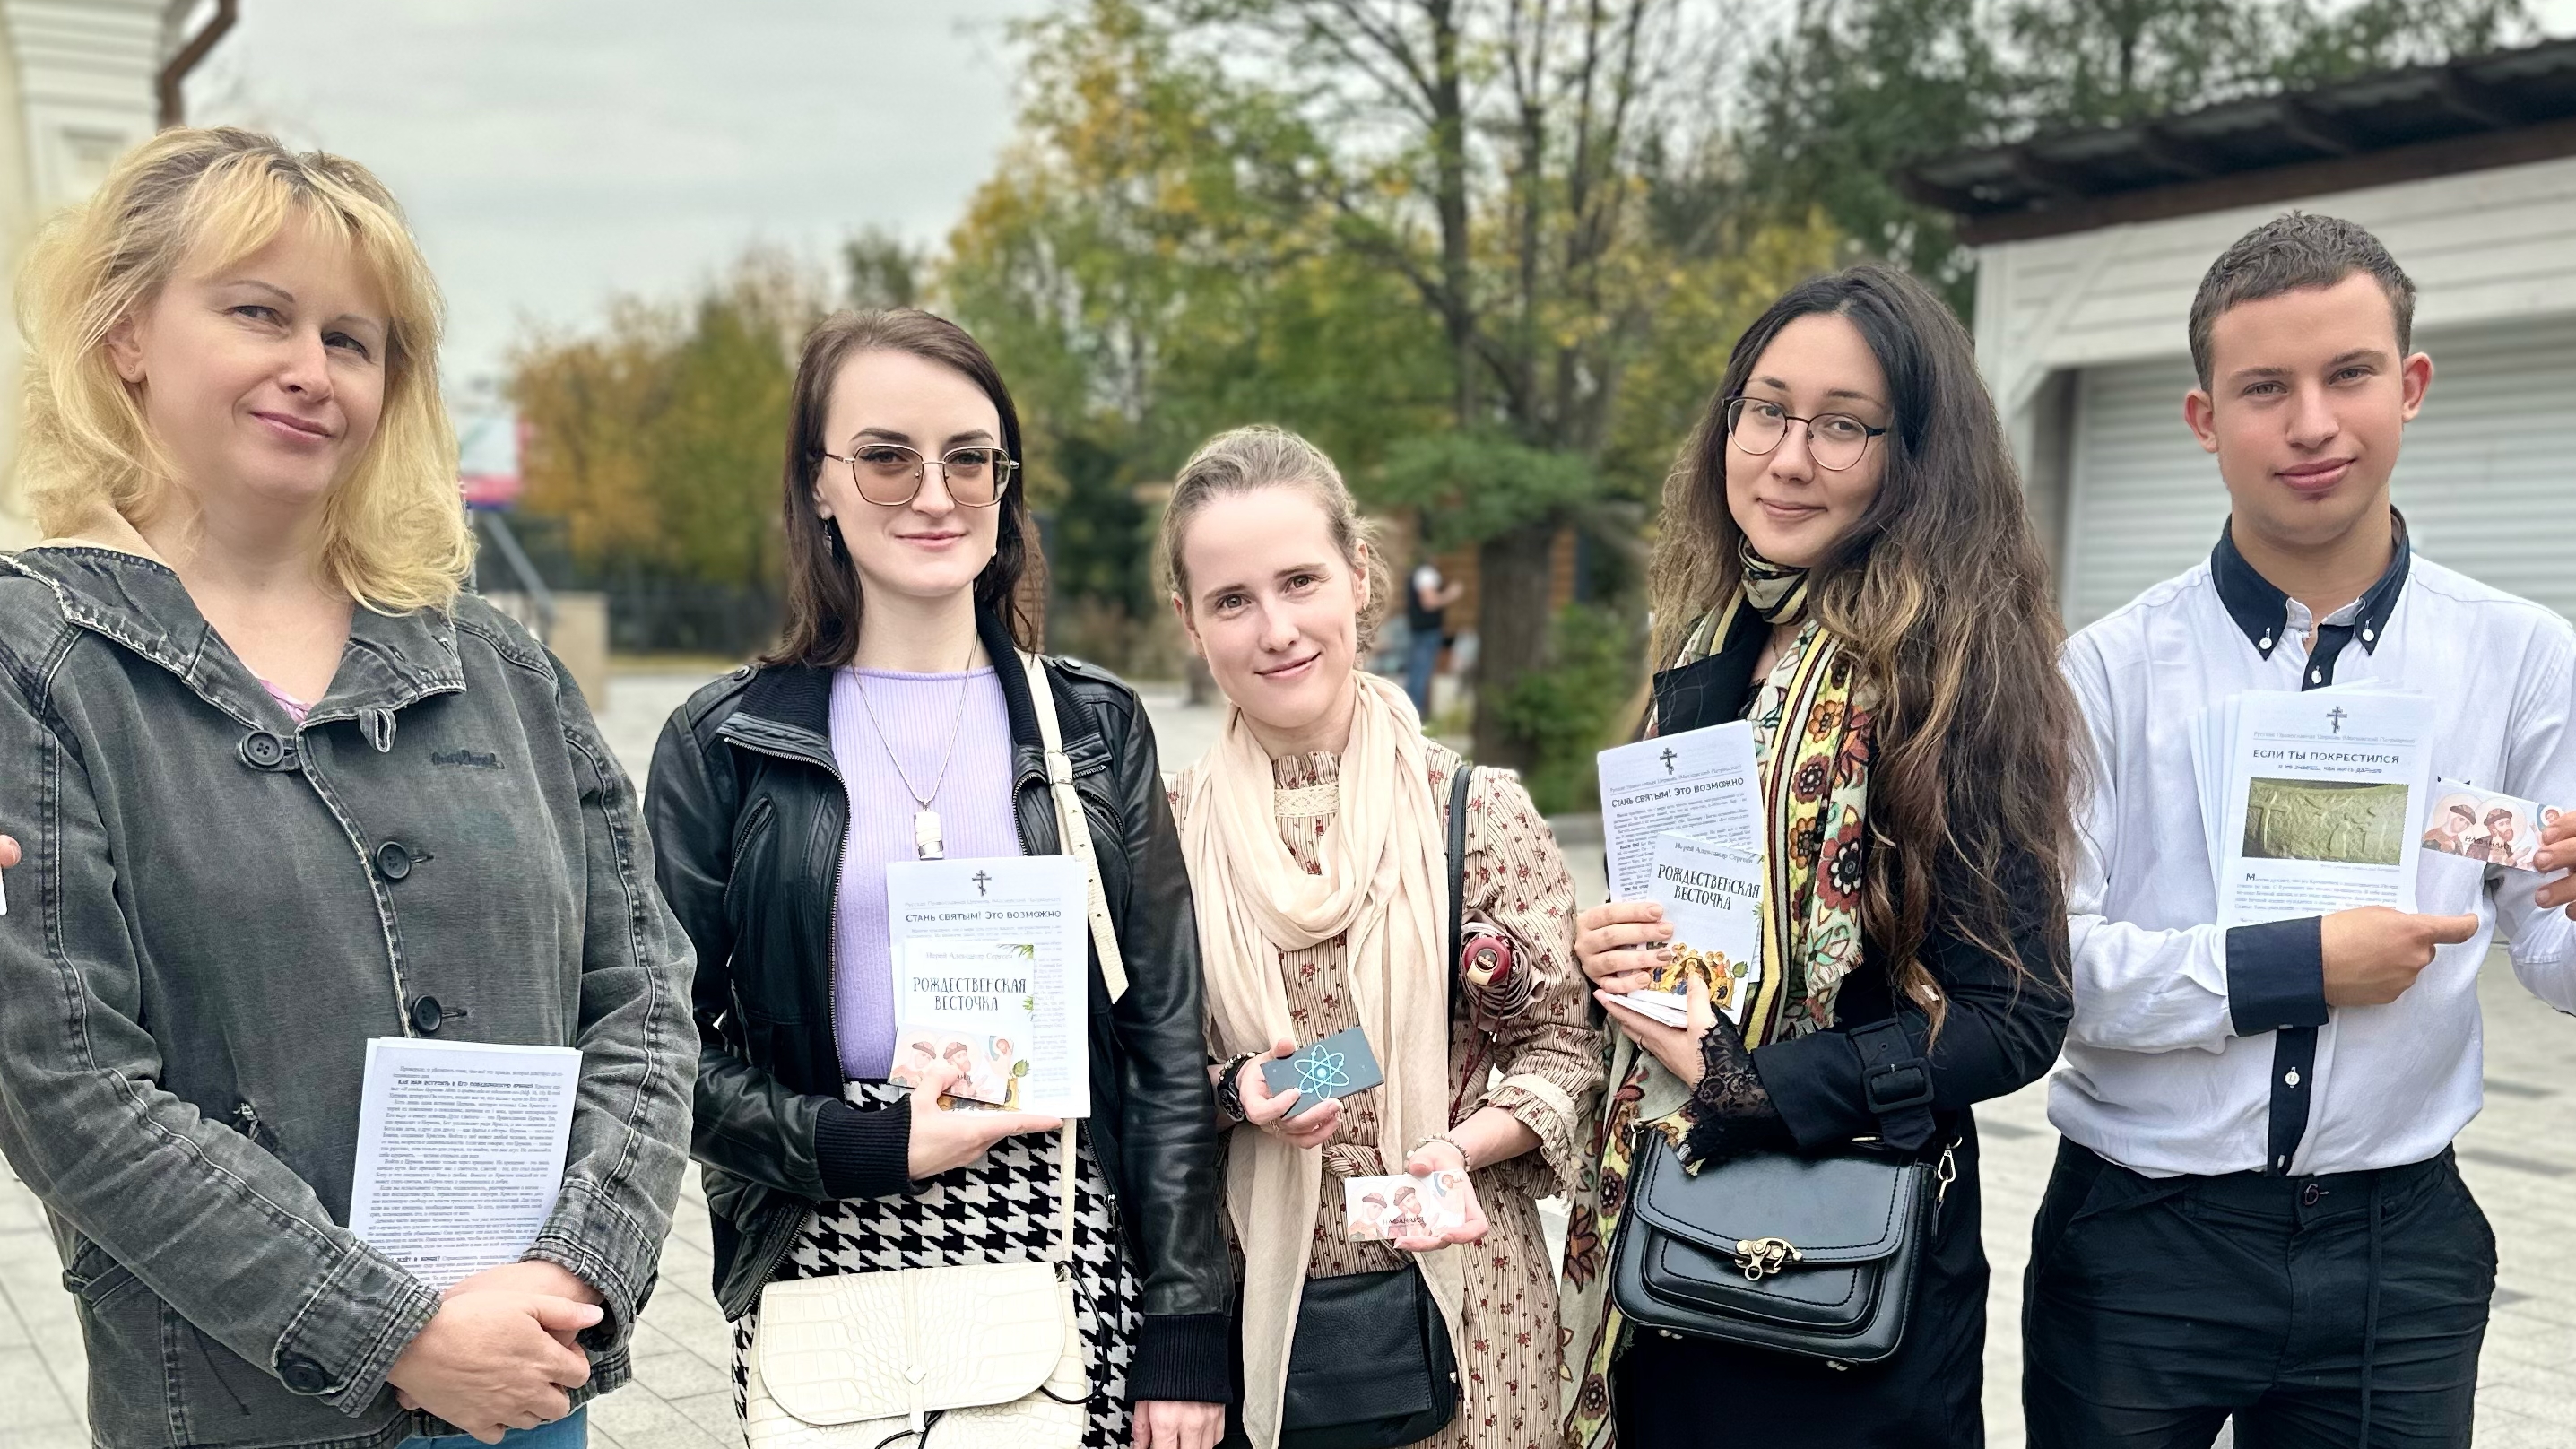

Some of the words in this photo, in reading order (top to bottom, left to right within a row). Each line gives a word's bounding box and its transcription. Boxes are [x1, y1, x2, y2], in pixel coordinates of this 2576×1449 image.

[2253, 750, 2284, 759] ЕСЛИ
[2288, 751, 2306, 759] ТЫ
[2311, 752, 2399, 764] ПОКРЕСТИЛСЯ
[1611, 797, 1634, 808] СТАНЬ
[1635, 789, 1671, 804] СВЯТЫМ!
[1674, 786, 1691, 797] ЭТО
[1694, 777, 1744, 794] ВОЗМОЖНО
[1657, 863, 1761, 899] РОЖДЕСТВЕНСКАЯ
[1674, 884, 1731, 911] ВЕСТОЧКА
[906, 914, 935, 923] СТАНЬ
[939, 911, 981, 922] СВЯТЫМ!
[985, 911, 1004, 920] ЭТО
[1007, 910, 1062, 919] ВОЗМОЖНО
[913, 977, 1027, 993] РОЖДЕСТВЕНСКАЯ
[934, 995, 999, 1011] ВЕСТОЧКА
